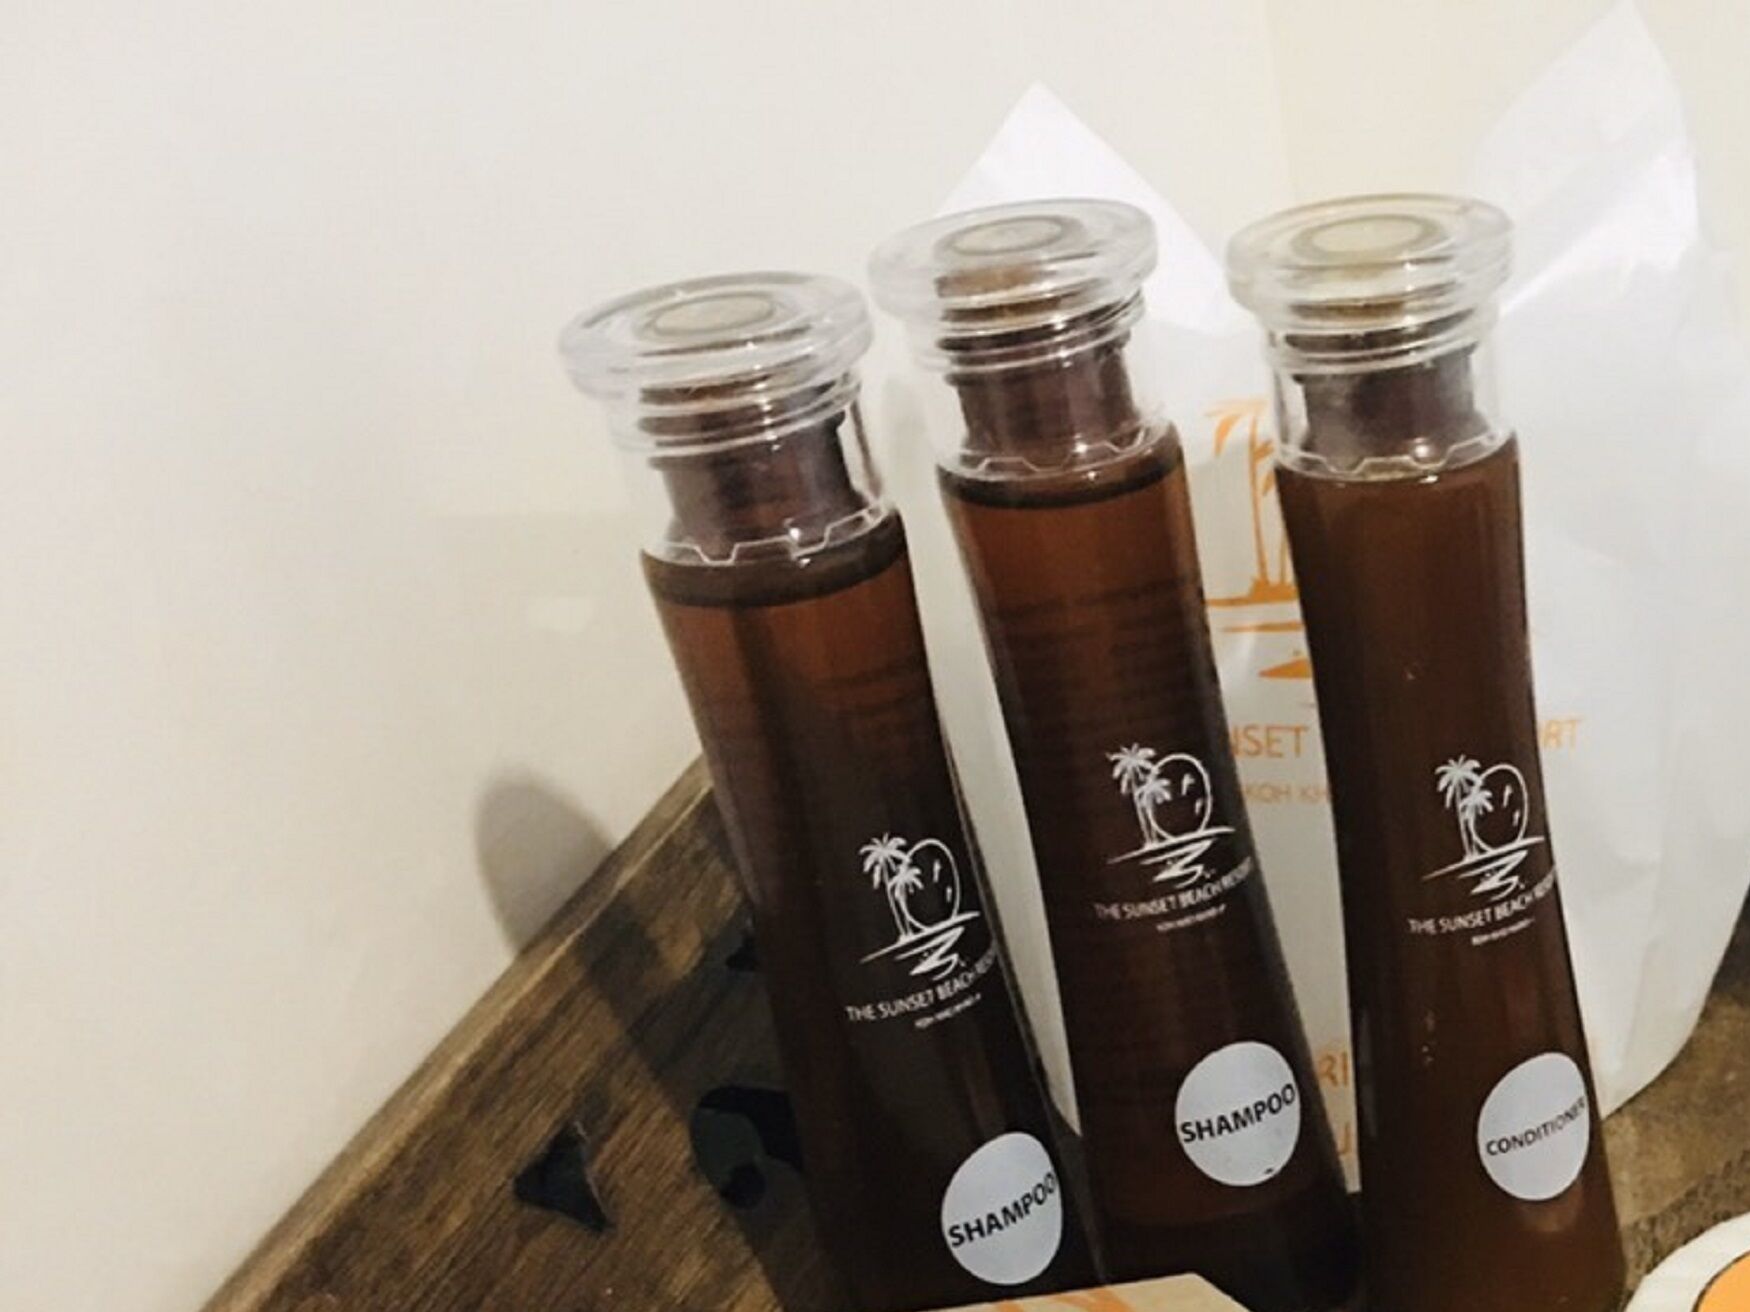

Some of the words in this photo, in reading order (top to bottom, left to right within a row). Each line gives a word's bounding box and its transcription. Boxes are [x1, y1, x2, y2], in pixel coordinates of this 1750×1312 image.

[1230, 724, 1310, 758] NSET
[1438, 908, 1492, 933] SUNSET
[846, 1004, 877, 1021] THE
[877, 989, 934, 1019] SUNSET
[1180, 1083, 1297, 1143] SHAMPOO
[1486, 1096, 1586, 1157] CONDITIONER
[948, 1170, 1060, 1248] SHAMPOO
